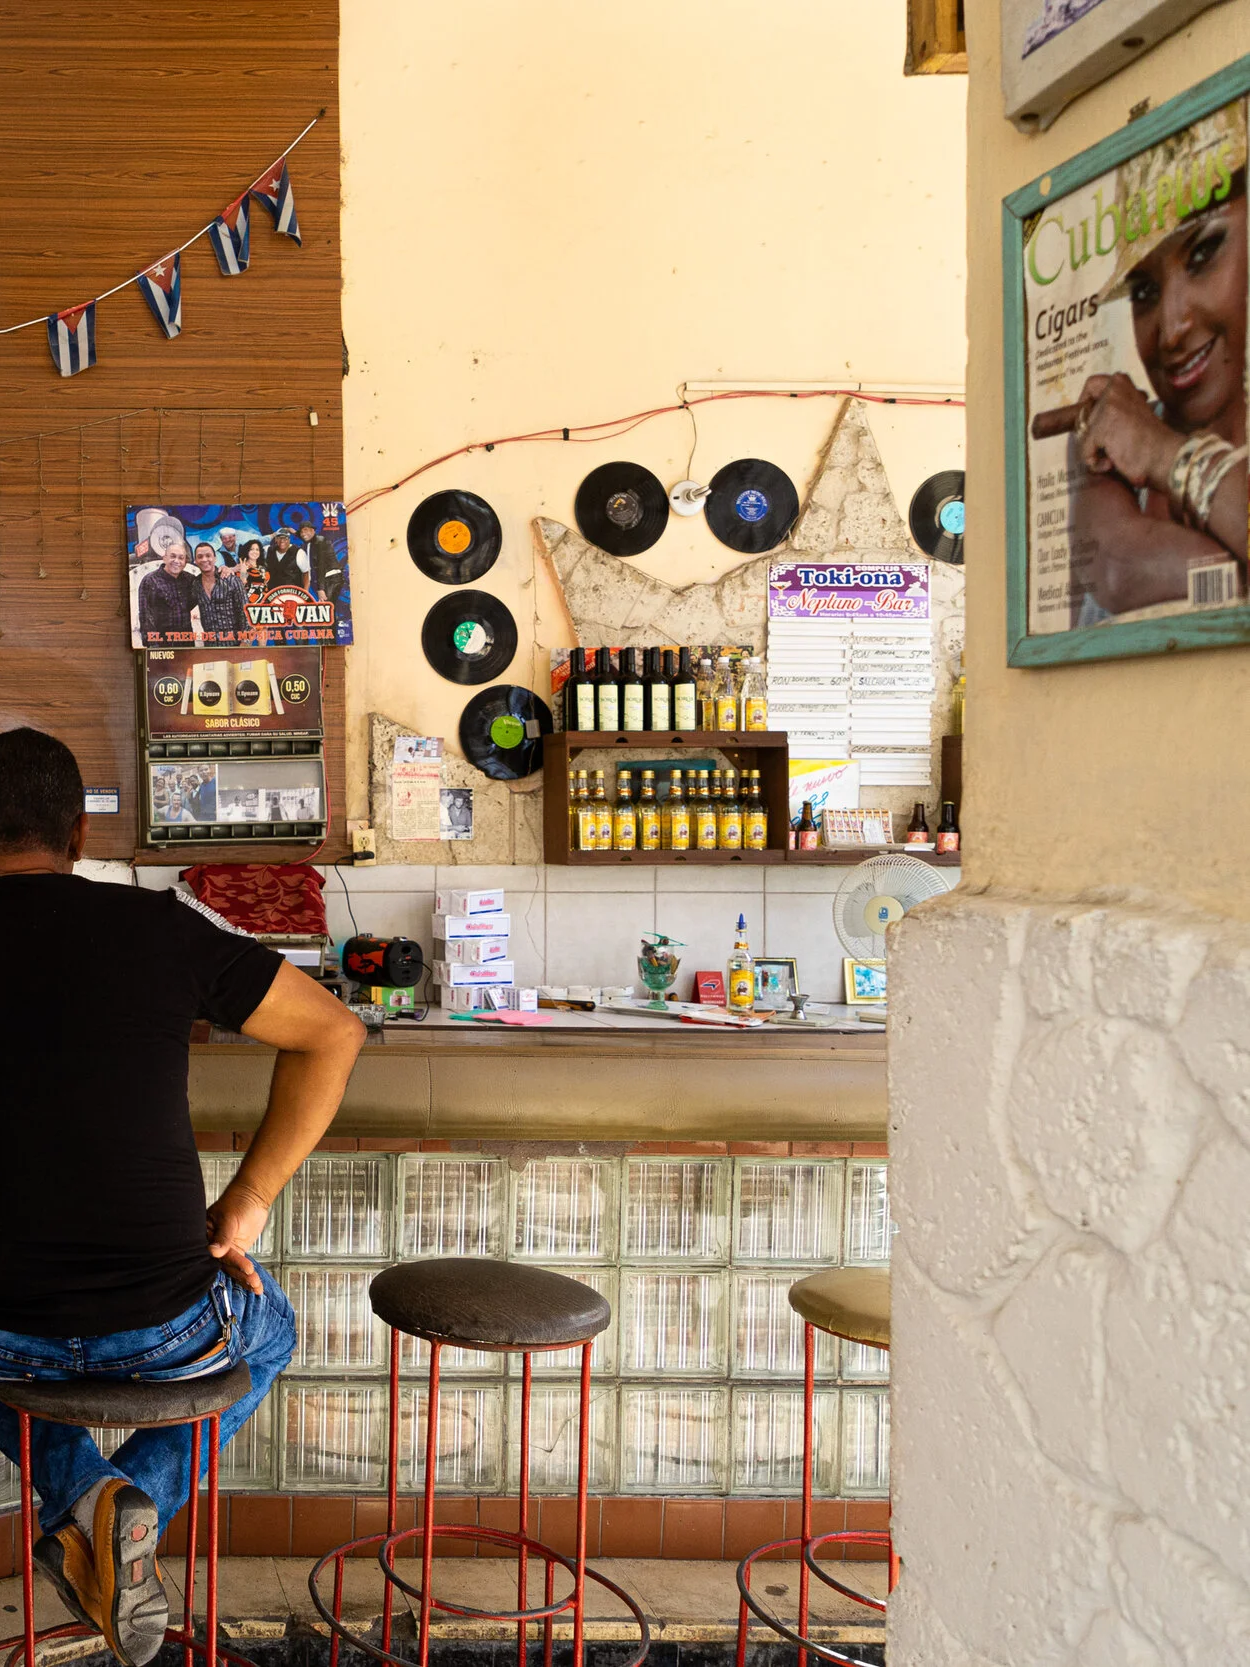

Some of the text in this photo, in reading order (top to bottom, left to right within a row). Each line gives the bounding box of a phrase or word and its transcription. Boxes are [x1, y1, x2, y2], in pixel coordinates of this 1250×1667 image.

[1035, 291, 1099, 343] Cigars
[322, 517, 339, 527] 45
[799, 568, 904, 587] Toki-ona
[786, 588, 863, 615] Neptuno
[247, 605, 331, 624] VAN VAN
[147, 632, 164, 642] EL
[165, 632, 197, 642] TREN
[201, 632, 217, 642] DE
[219, 631, 235, 641] LA
[285, 628, 335, 640] CUBANA
[149, 651, 175, 660] NUEVOS
[205, 716, 260, 729] SABOR CLÁSICO
